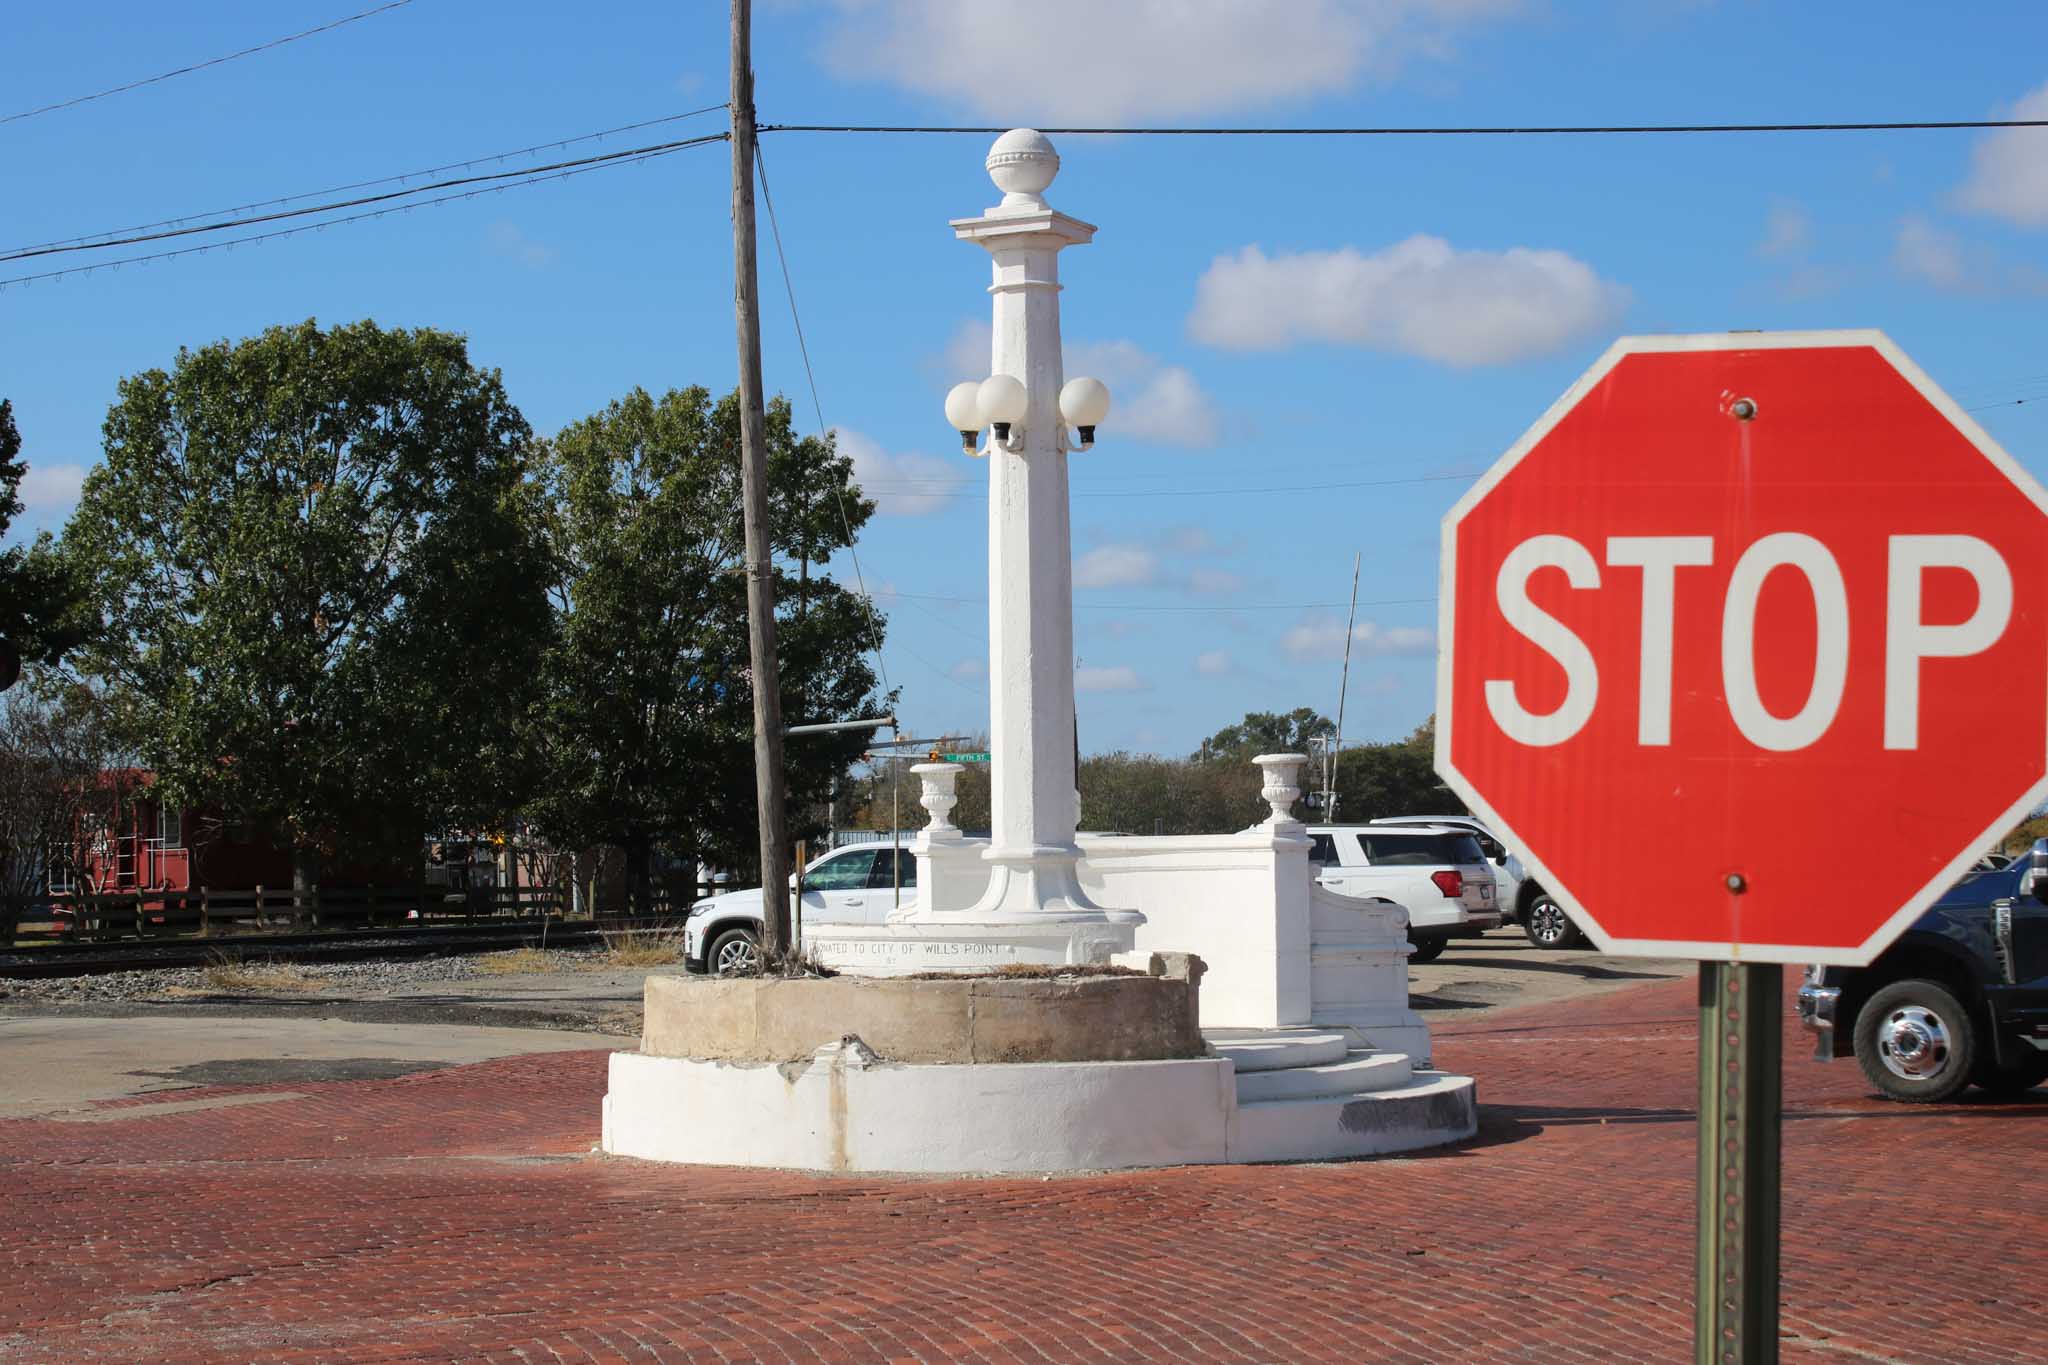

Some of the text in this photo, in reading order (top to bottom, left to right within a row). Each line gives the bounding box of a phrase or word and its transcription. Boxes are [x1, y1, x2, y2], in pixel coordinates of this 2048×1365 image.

[1485, 533, 2014, 751] STOP
[854, 943, 865, 953] TO
[871, 943, 893, 954] CITY
[901, 943, 915, 954] OF
[925, 943, 959, 955] WILLS
[964, 943, 1001, 954] POINT
